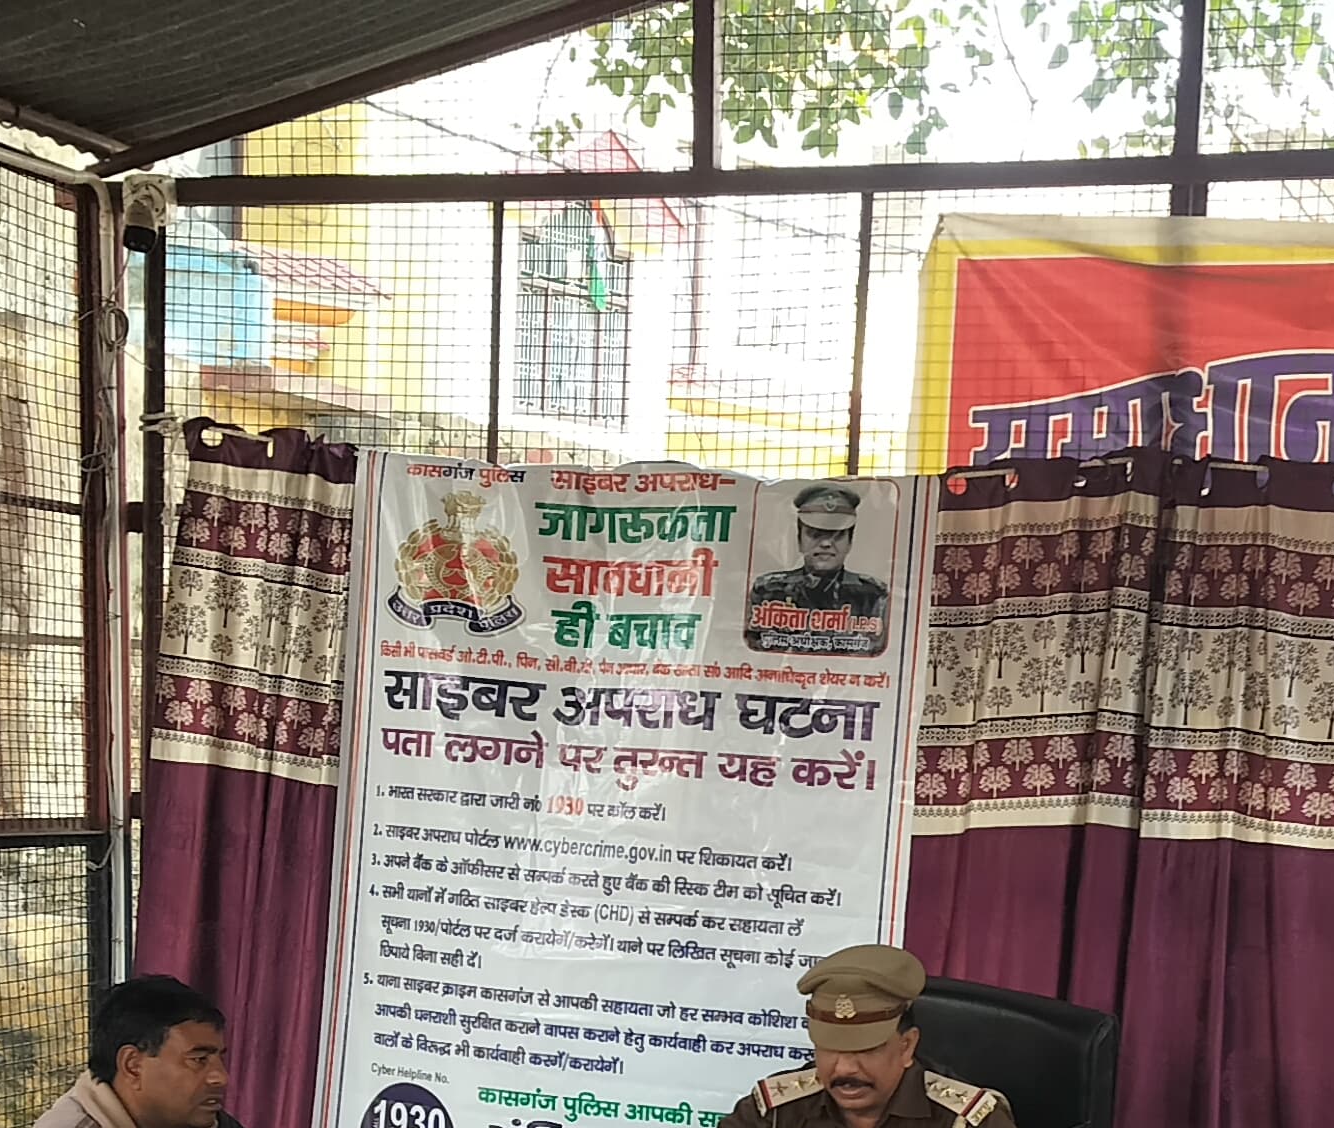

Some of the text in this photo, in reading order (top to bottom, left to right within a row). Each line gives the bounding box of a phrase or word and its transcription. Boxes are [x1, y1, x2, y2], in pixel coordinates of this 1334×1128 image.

[407, 462, 527, 487] कासगंज पुलिस
[551, 469, 630, 495] साइबर
[543, 547, 719, 598] सावधानी
[429, 602, 474, 620] प्रदेश
[551, 601, 702, 650] ही बचाव
[752, 600, 810, 630] अंकिता
[811, 604, 850, 631] शर्मा
[381, 640, 401, 657] किसी
[404, 641, 416, 657] भी
[724, 663, 752, 681] आदि
[820, 668, 846, 686] शेयर
[384, 669, 881, 741] साइबर अपराध घटना
[382, 727, 435, 758] पता
[444, 729, 548, 769] लगने
[557, 743, 607, 774] पर
[612, 747, 707, 790] तुरन्त
[717, 753, 780, 788] यह
[376, 786, 385, 797] 1.
[388, 785, 415, 801] भारत
[417, 787, 458, 805] सरकार
[460, 790, 486, 809] द्वारा
[489, 791, 520, 810] जारी
[546, 795, 584, 816] 1930
[587, 802, 604, 817] पर
[606, 801, 637, 820] कॉल
[373, 824, 383, 836] 2.
[385, 824, 420, 841] साइबर
[421, 828, 461, 844] अपराध
[464, 829, 500, 849] पोर्टल
[503, 836, 672, 865] www.cybercrime.gov.in
[676, 850, 695, 865] पर
[698, 847, 757, 869] शिकायत
[371, 853, 381, 866] 3.
[383, 853, 410, 870] अपने
[435, 857, 448, 873] के
[450, 858, 505, 880] ऑफीसर
[507, 862, 521, 881] से
[523, 866, 567, 885] सम्पर्क
[568, 870, 599, 889] करते
[601, 874, 622, 897] हुए
[651, 876, 671, 894] की
[713, 879, 739, 899] टीम
[743, 882, 762, 901] को
[766, 885, 807, 908] सूचित
[369, 883, 379, 897] 4.
[382, 883, 404, 900] सभी
[435, 886, 445, 905] में
[447, 888, 480, 908] गठित
[484, 894, 528, 913] साइबर
[530, 896, 557, 916] हेल्प
[559, 898, 591, 919] डेस्क
[594, 903, 635, 928] (CHD)
[638, 906, 650, 925] से
[654, 909, 699, 929] सम्पर्क
[702, 916, 725, 931] कर
[729, 917, 784, 936] सहायता
[787, 918, 804, 938] लें
[381, 914, 411, 934] सूचना
[474, 926, 491, 941] पर
[494, 926, 519, 945] दर्ज
[646, 941, 665, 957] पर
[668, 940, 717, 961] लिखित
[719, 948, 760, 968] सूचना
[764, 948, 794, 968] कोई
[412, 945, 437, 963] बिना
[438, 948, 464, 967] सही
[363, 973, 373, 985] 5.
[403, 977, 439, 995] साइबर
[442, 981, 477, 999] क्राइम
[480, 985, 534, 1005] कासगंज
[537, 989, 550, 1007] से
[553, 992, 598, 1012] आपकी
[601, 998, 653, 1017] सहायता
[657, 1000, 675, 1019] जो
[679, 1005, 698, 1022] हर
[701, 1008, 744, 1026] सम्भव
[748, 1008, 797, 1029] कोशिश
[374, 1002, 411, 1020] आपकी
[459, 1012, 502, 1035] सुरक्षित
[505, 1018, 541, 1036] कराने
[543, 1023, 579, 1040] वापस
[582, 1027, 620, 1046] कराने
[624, 1028, 645, 1052] हेतु
[648, 1031, 707, 1053] कार्यवाही
[710, 1039, 734, 1055] कर
[737, 1041, 783, 1060] अपराध
[374, 1030, 398, 1048] वालों
[401, 1033, 414, 1049] के
[455, 1040, 470, 1058] भी
[473, 1044, 526, 1066] कार्यवाही
[371, 1063, 450, 1084] Cyber Helpline No.
[478, 1086, 557, 1112] कासगंज
[563, 1092, 619, 1122] पुलिस
[625, 1102, 693, 1128] आपकी
